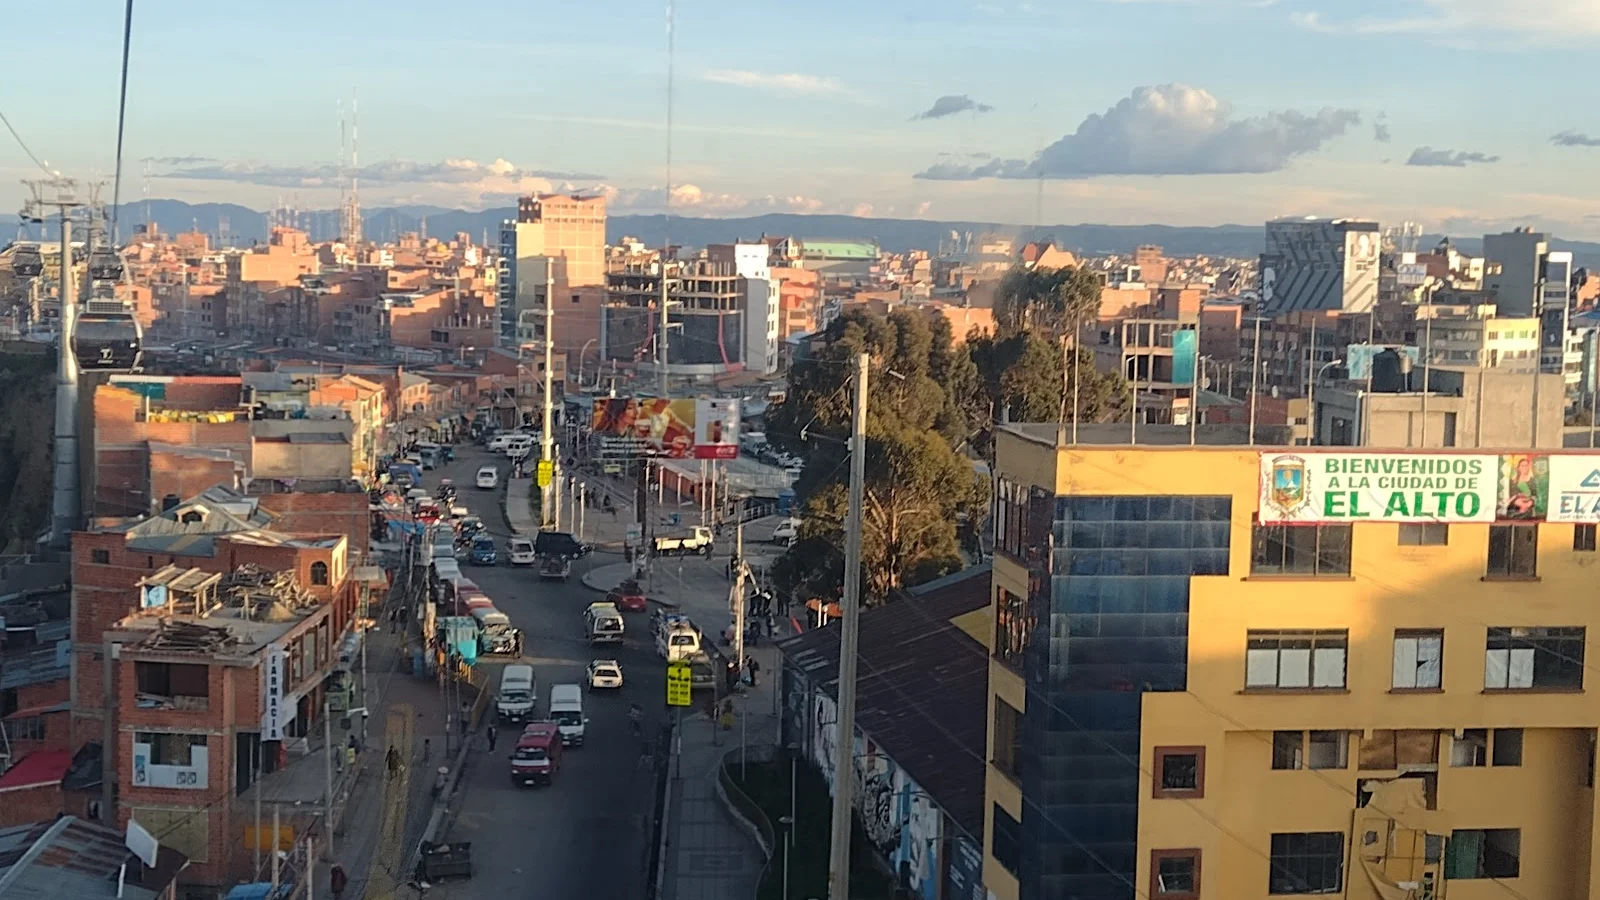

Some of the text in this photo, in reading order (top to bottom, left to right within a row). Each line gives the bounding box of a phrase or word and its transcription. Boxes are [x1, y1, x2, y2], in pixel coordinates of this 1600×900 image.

[1325, 458, 1482, 475] BIENVENIDOS
[1328, 476, 1478, 489] A LA CIUDAD DE
[1323, 490, 1481, 518] EL ALTO
[1560, 495, 1586, 514] EL
[270, 655, 278, 738] FARMACIA
